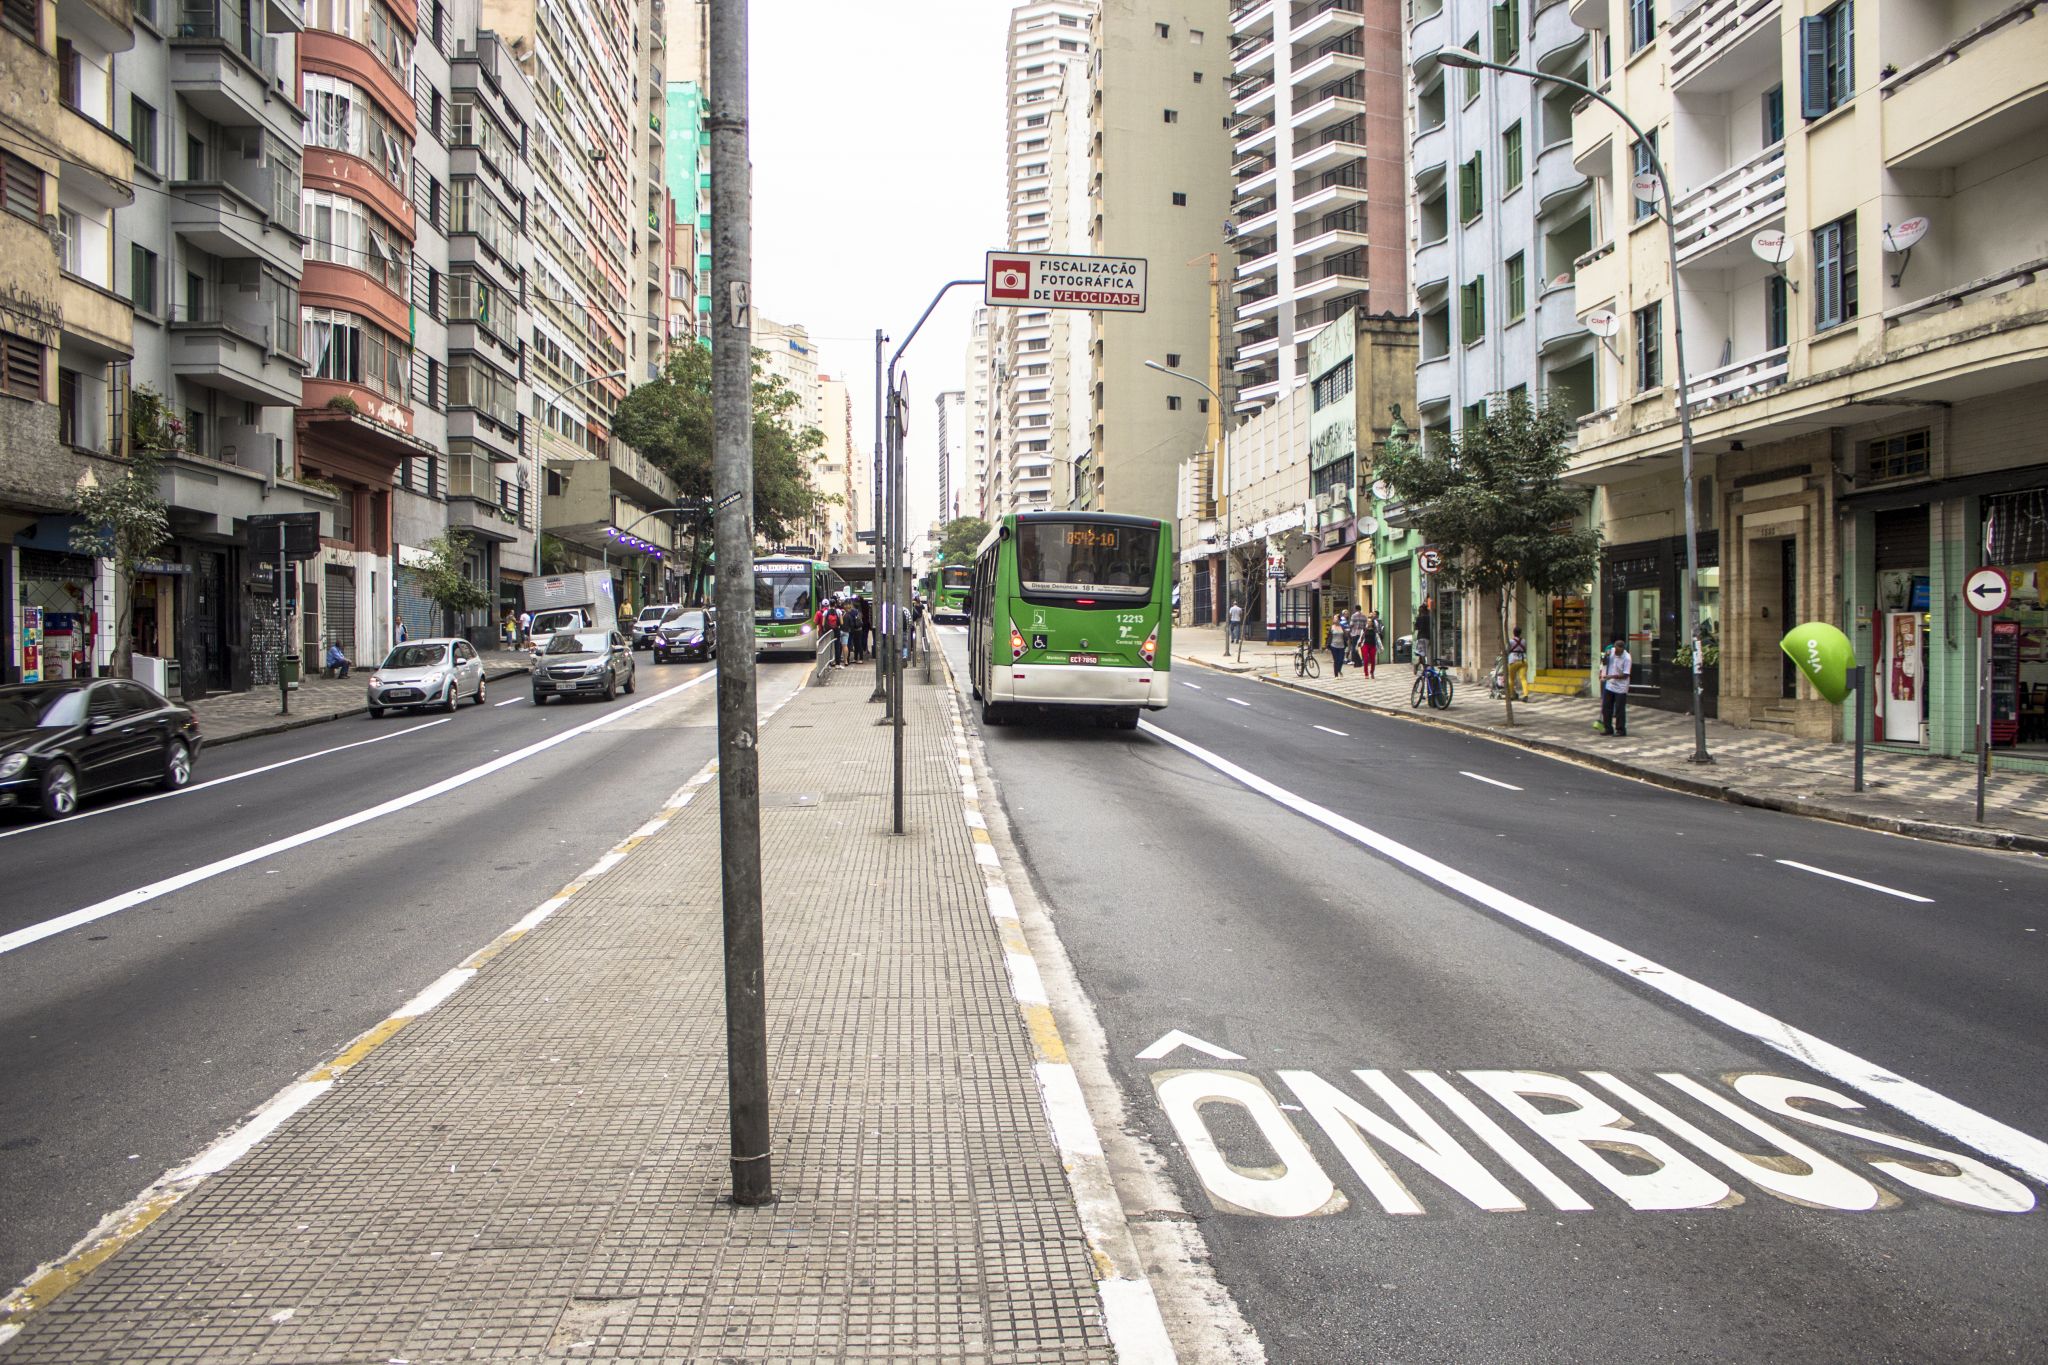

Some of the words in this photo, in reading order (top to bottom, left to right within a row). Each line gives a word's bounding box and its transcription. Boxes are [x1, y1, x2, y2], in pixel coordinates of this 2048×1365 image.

[1040, 260, 1137, 275] FISCALIZAÇÃO
[1041, 274, 1134, 288] FOTOGRÁFICA
[1034, 290, 1051, 300] DE
[1055, 291, 1139, 304] VELOCIDADE
[1122, 614, 1144, 624] 2213
[1807, 639, 1822, 674] vivo
[1135, 1029, 2036, 1217] ÔNIBUS
